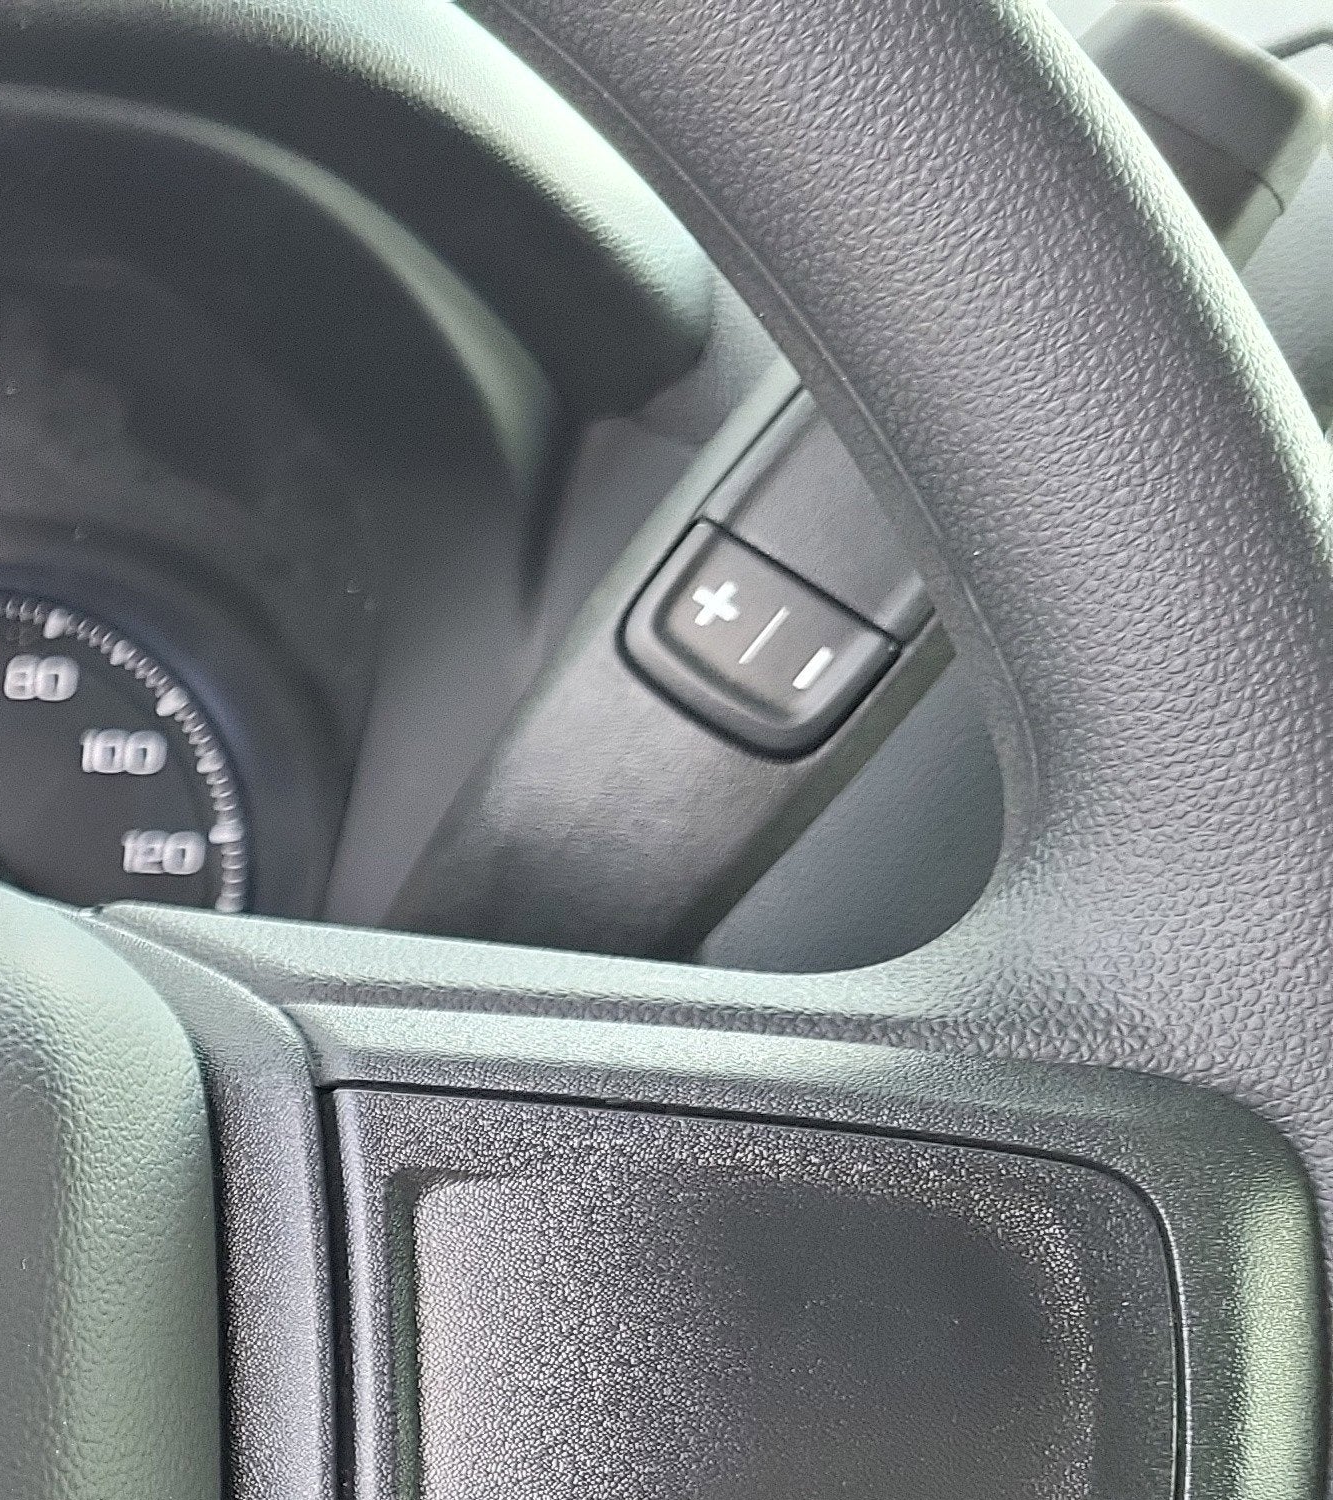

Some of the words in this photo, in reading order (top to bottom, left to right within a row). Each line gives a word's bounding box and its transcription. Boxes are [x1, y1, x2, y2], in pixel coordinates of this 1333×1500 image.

[3, 654, 80, 702] 80
[80, 728, 167, 775] 100
[121, 829, 207, 875] 120
